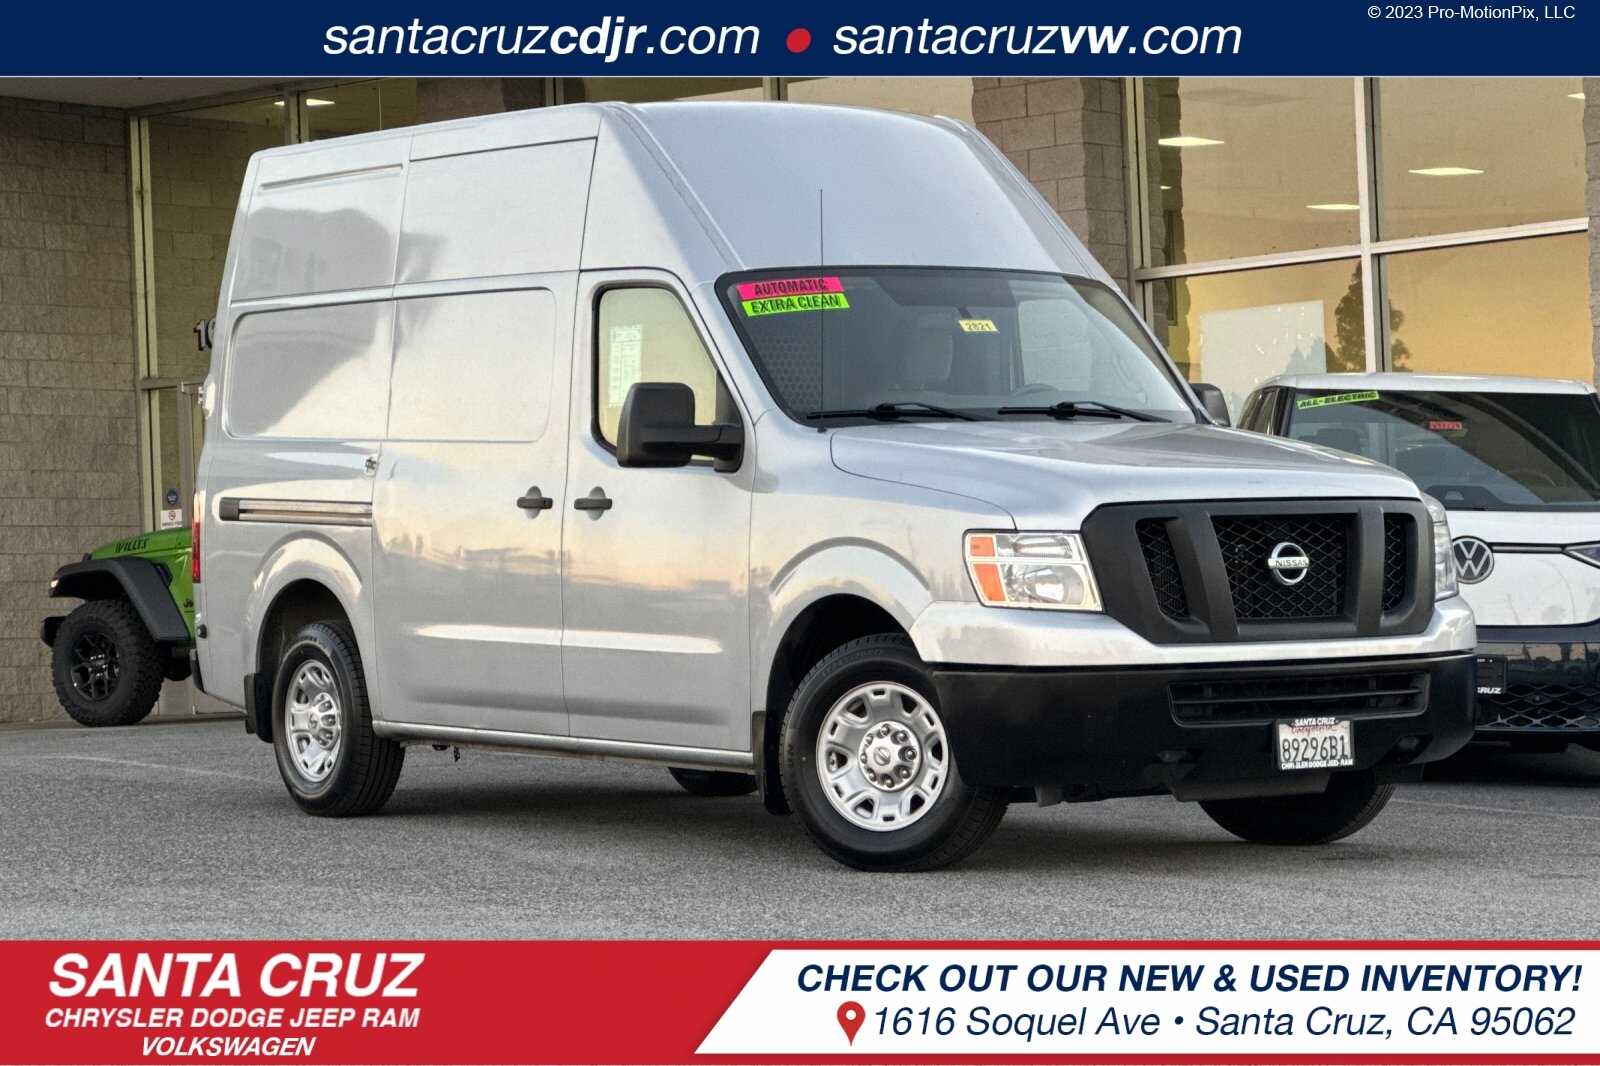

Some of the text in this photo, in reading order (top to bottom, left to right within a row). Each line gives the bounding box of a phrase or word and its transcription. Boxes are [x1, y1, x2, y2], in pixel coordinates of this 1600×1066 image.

[754, 278, 826, 296] AUTOMATIC
[751, 294, 840, 313] EXTRA CLEAN
[1299, 391, 1377, 408] ALL-ELECTRIC
[1274, 559, 1308, 569] NISSAN
[1294, 716, 1336, 726] SANTA CRUZ
[1282, 734, 1349, 762] 89296B1
